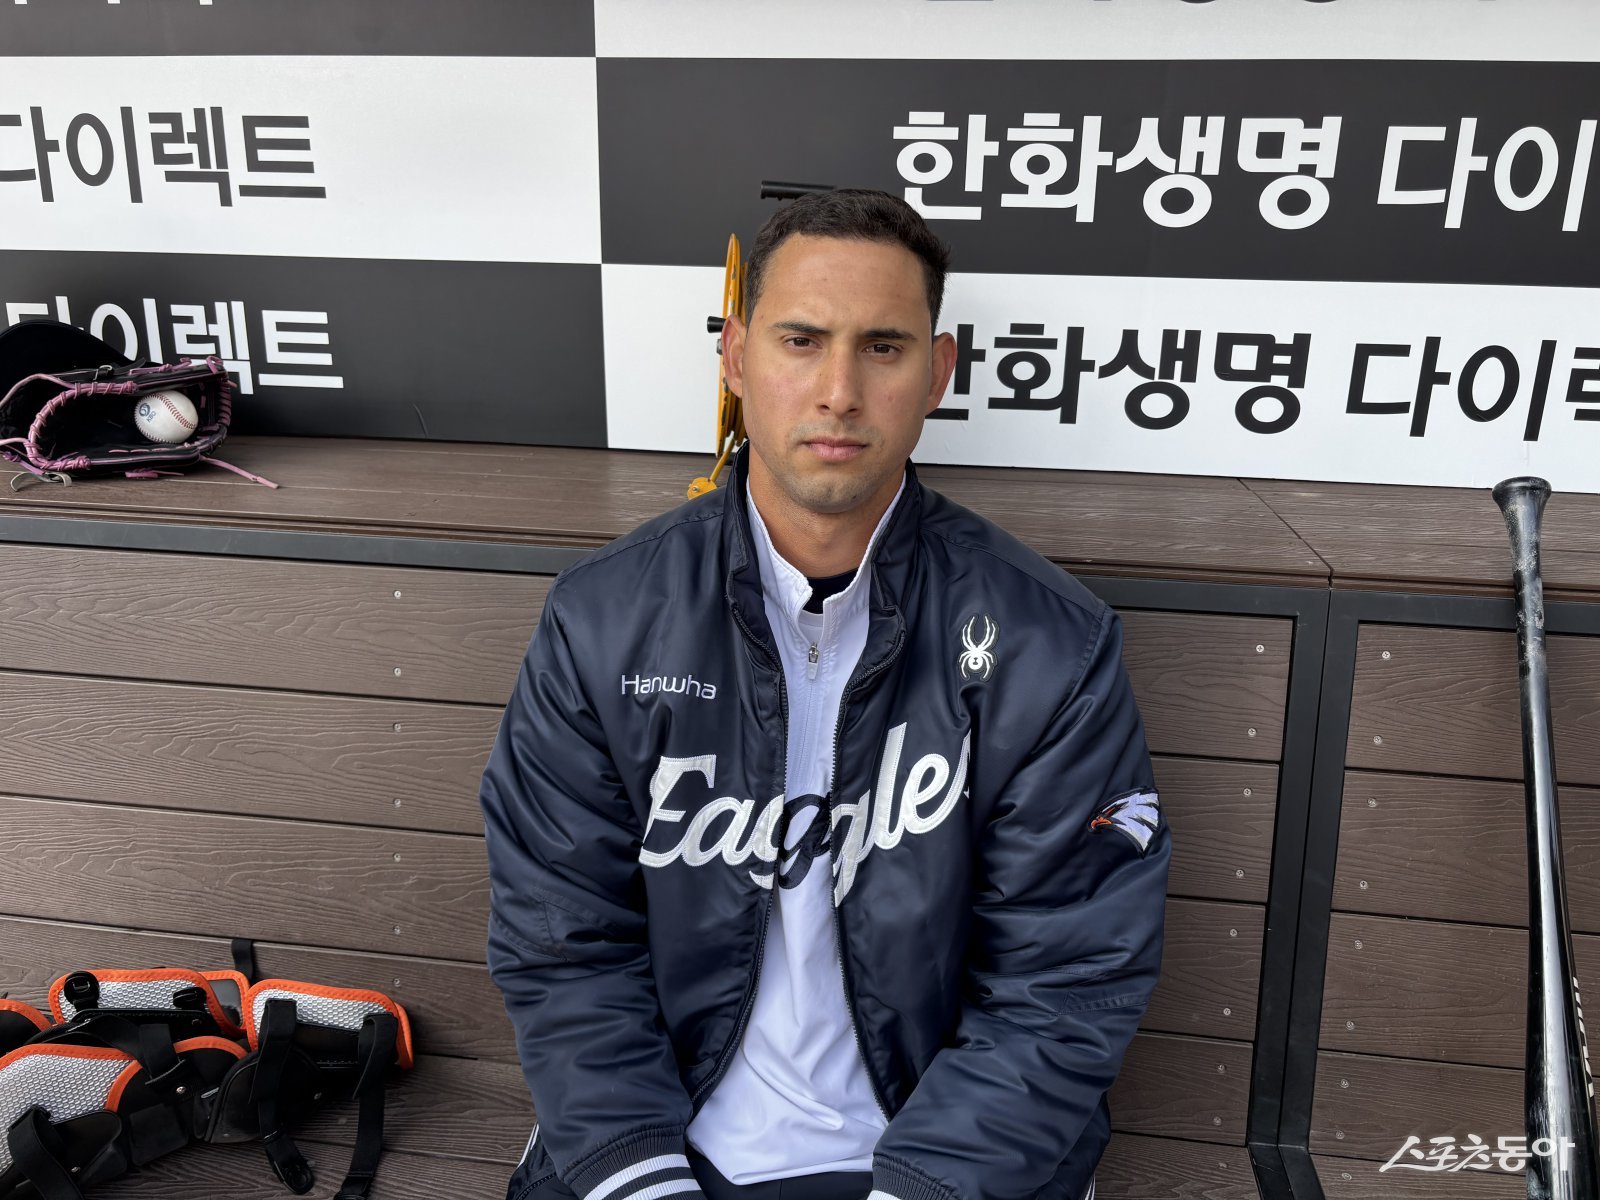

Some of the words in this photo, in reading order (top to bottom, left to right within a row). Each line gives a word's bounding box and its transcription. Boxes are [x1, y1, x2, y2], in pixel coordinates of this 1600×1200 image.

[893, 112, 1342, 229] 한화생명
[621, 674, 717, 700] Hanwha
[638, 722, 971, 908] Eagle
